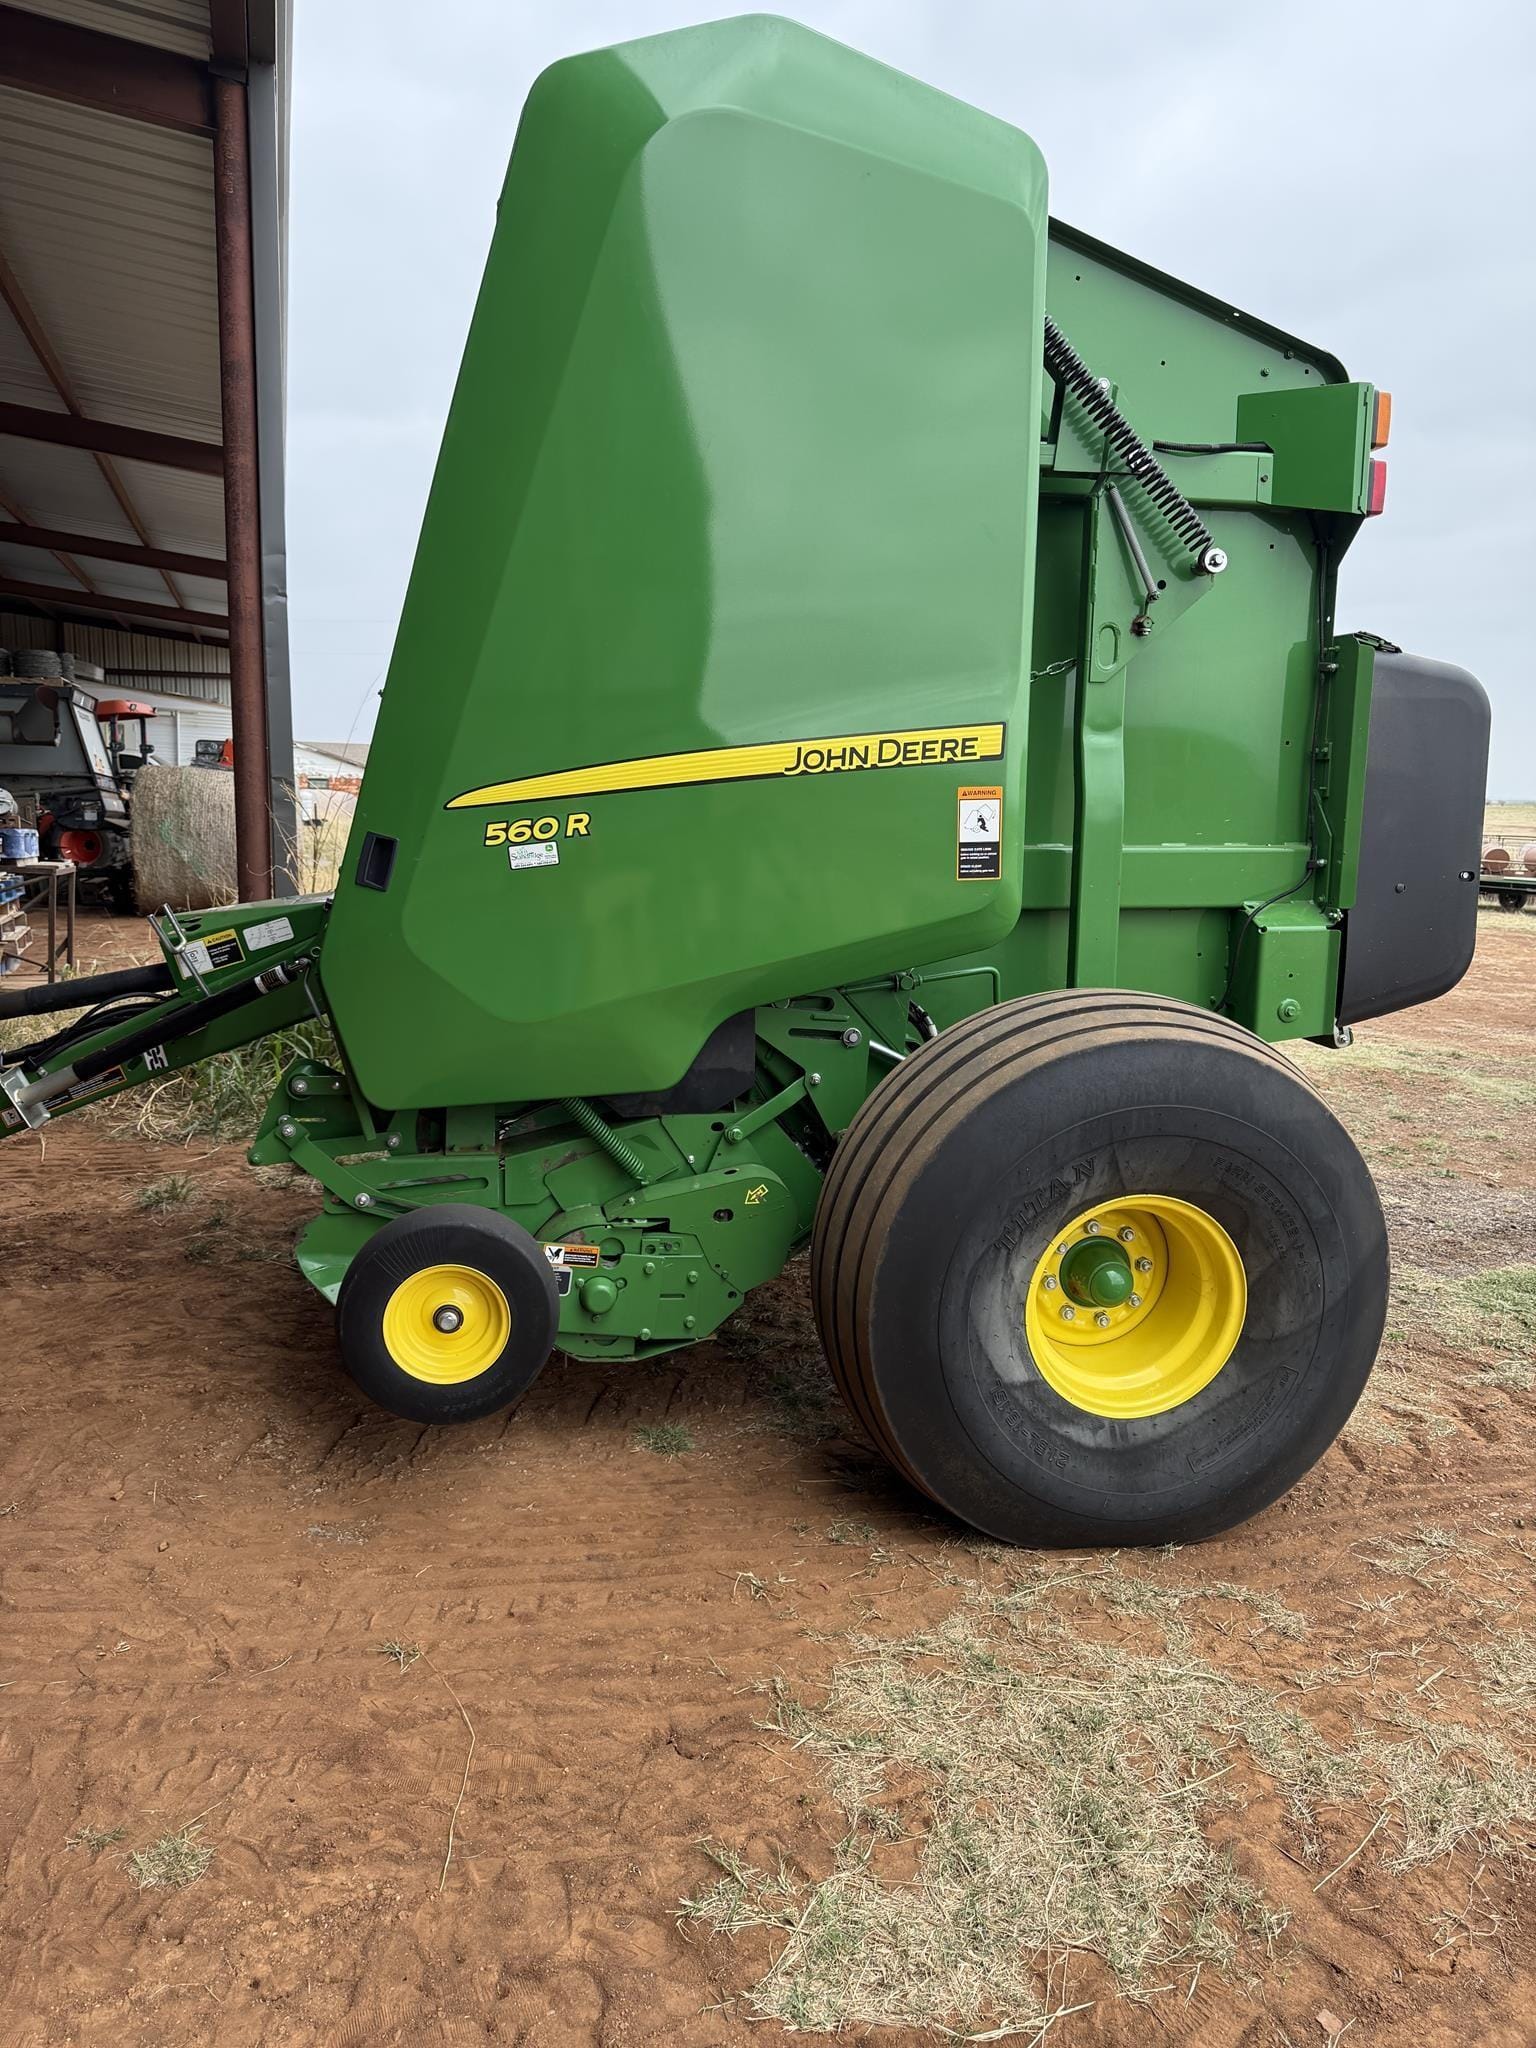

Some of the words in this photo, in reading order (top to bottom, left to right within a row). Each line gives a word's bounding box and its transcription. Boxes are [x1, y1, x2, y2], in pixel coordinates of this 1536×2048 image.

[784, 745, 869, 772] JOHN
[877, 736, 979, 764] DEERE
[967, 789, 997, 797] WARNING
[484, 816, 560, 847] 560
[565, 812, 591, 838] R
[994, 1154, 1097, 1252] TITAN
